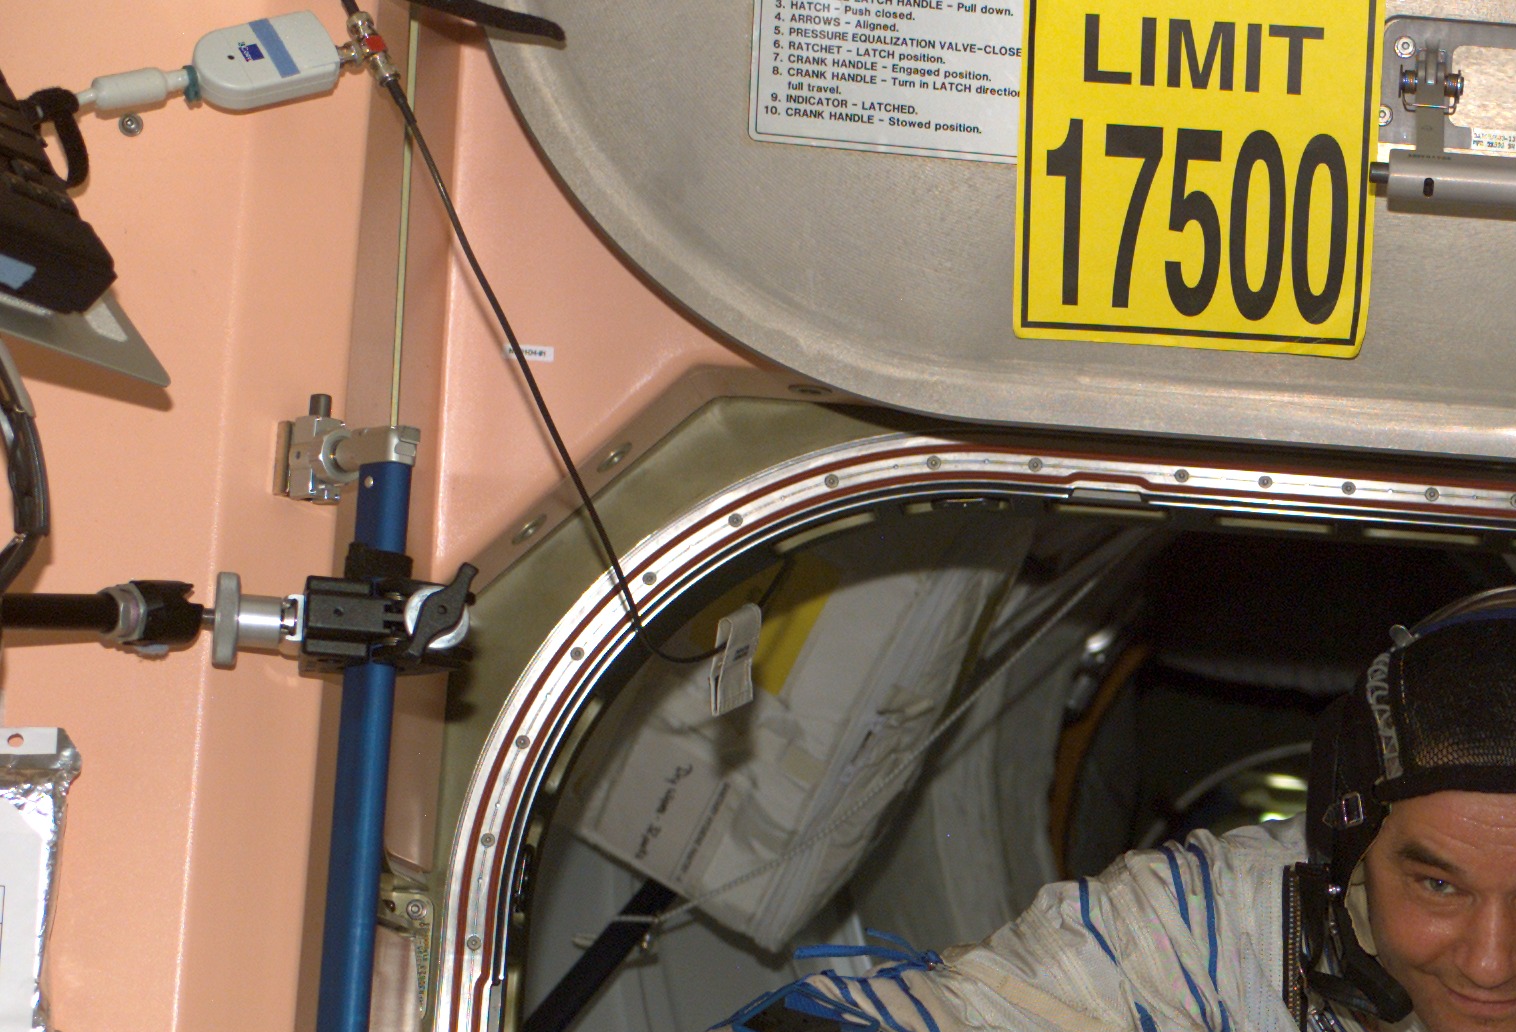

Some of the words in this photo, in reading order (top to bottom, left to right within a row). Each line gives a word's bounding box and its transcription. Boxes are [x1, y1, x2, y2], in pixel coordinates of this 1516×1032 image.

[775, 0, 785, 9] 3.
[790, 1, 830, 13] HATCH
[844, 6, 871, 17] Push
[875, 9, 915, 21] closed.
[957, 2, 977, 13] Pull
[981, 5, 1014, 17] down.
[774, 12, 784, 22] 4.
[790, 14, 840, 27] ARROWS
[855, 20, 899, 32] Aligned.
[773, 26, 784, 36] 5.
[789, 27, 848, 41] PRESSURE
[851, 33, 935, 49] EQUALIZATION
[773, 40, 784, 50] 6.
[788, 41, 842, 54] RATCHET
[856, 47, 895, 59] LATCH
[898, 52, 946, 64] position.
[1083, 13, 1325, 96] LIMIT
[773, 53, 783, 62] 7.
[788, 54, 827, 67] CRANK
[832, 58, 878, 71] HANDLE
[891, 64, 940, 77] Engaged
[944, 70, 991, 82] position.
[772, 66, 782, 76] 8.
[787, 67, 827, 80] CRANK
[831, 72, 877, 84] HANDLE
[891, 77, 915, 88] Turn
[920, 80, 929, 89] in
[933, 81, 971, 93] LATCH
[787, 81, 803, 91] full
[808, 83, 841, 95] travel.
[771, 93, 781, 102] 9.
[786, 94, 848, 108] INDICATOR
[861, 101, 918, 115] LATCHED.
[764, 105, 781, 116] 10.
[785, 107, 825, 120] CRANK
[829, 111, 875, 124] HANDLE
[888, 117, 931, 129] Stowed
[934, 122, 982, 134] position.
[1046, 118, 1349, 326] 17500
